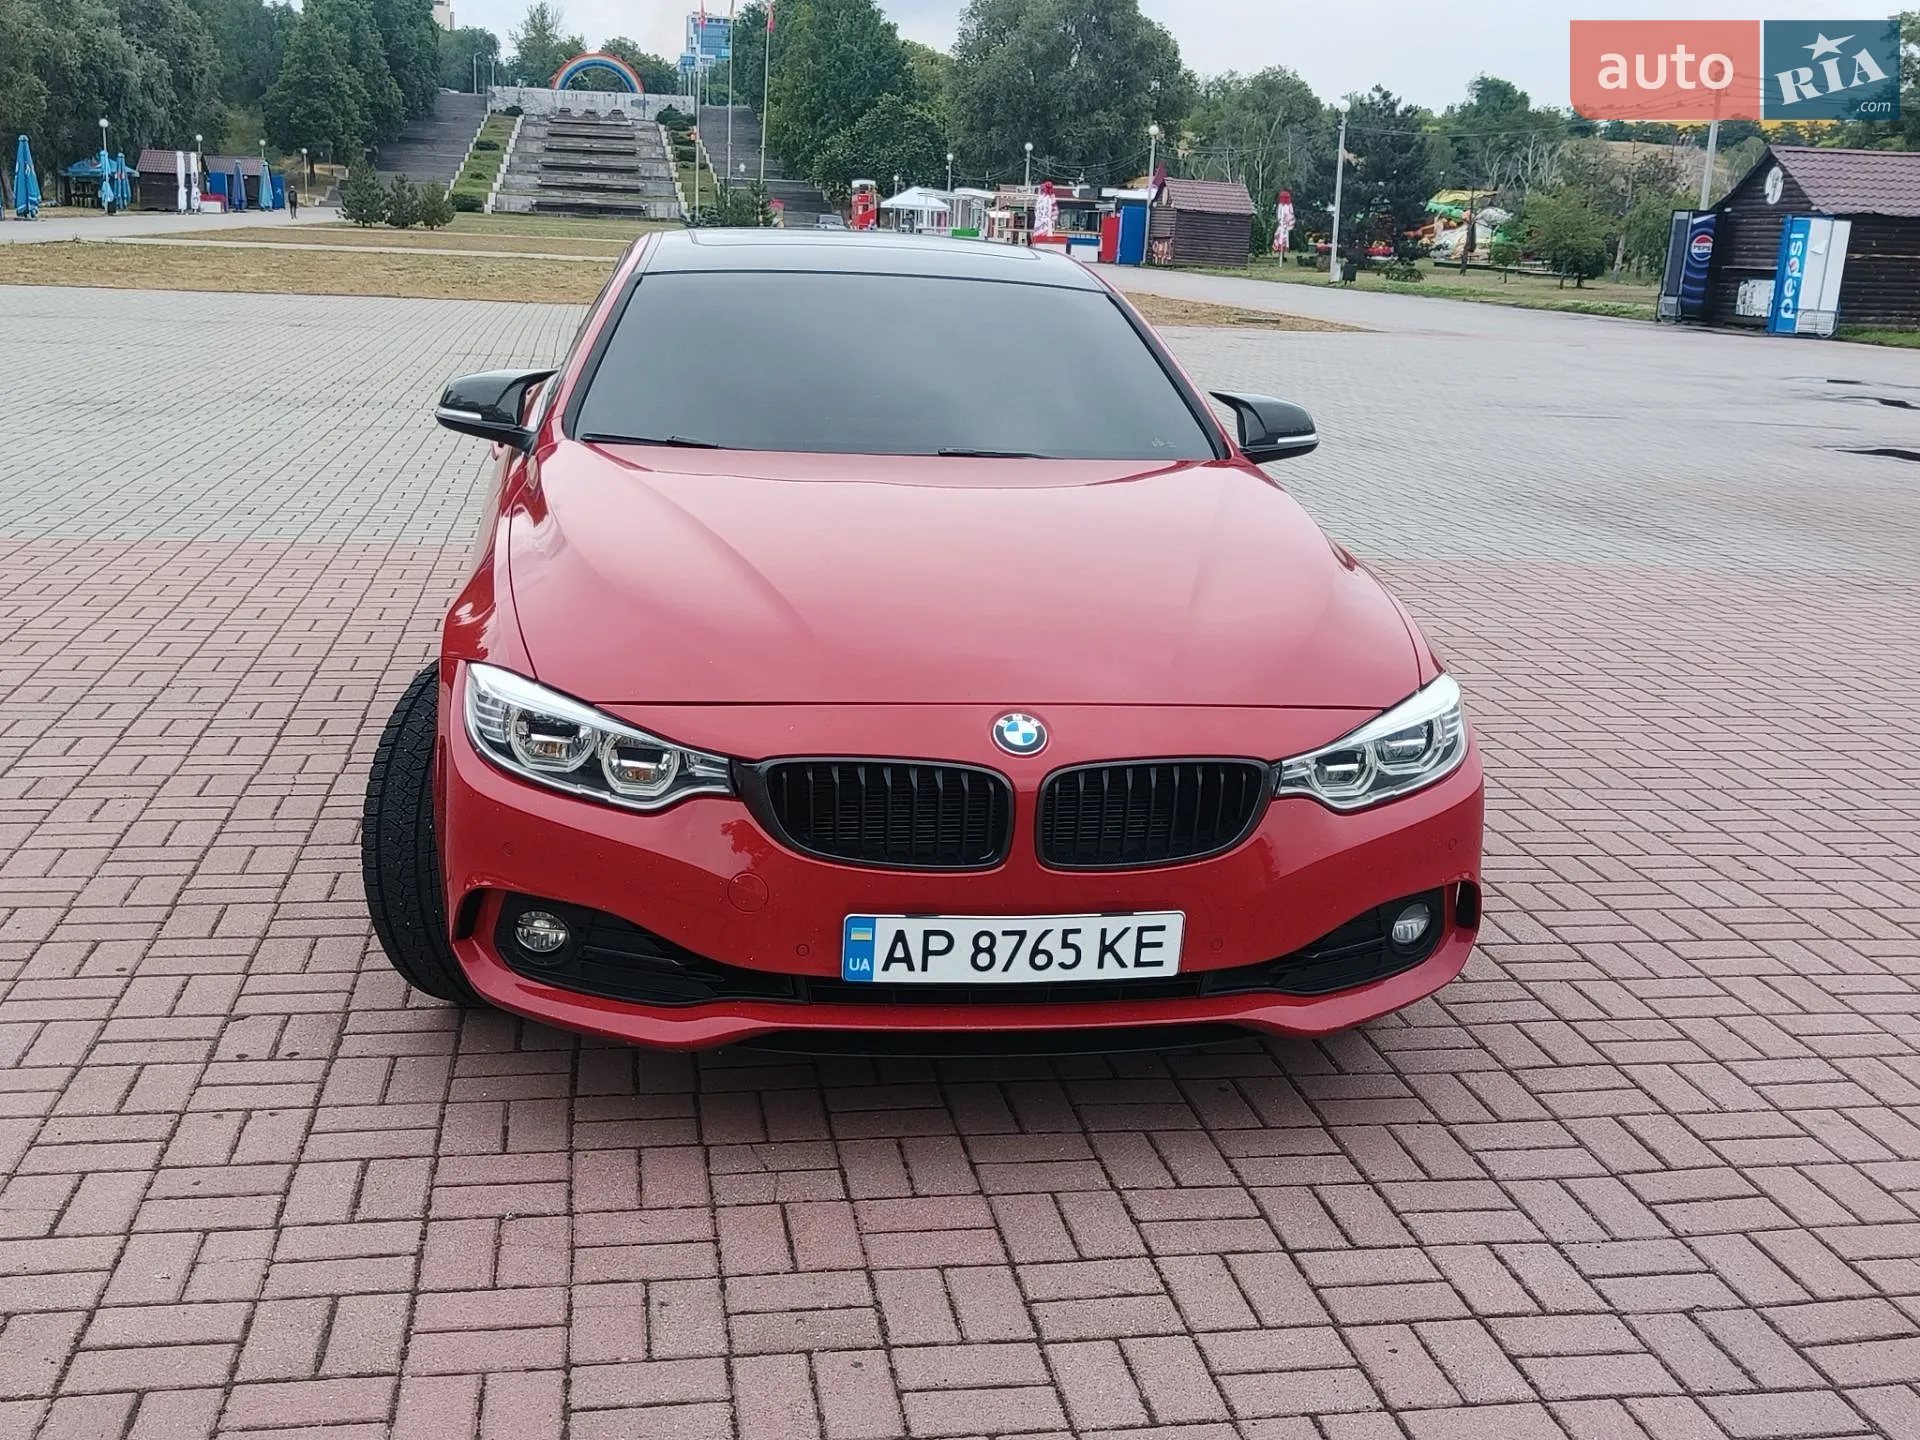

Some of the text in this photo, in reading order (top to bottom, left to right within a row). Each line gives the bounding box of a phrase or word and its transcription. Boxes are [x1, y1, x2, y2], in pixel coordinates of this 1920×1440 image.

[1780, 233, 1805, 319] pepsi
[849, 957, 871, 972] UA
[881, 925, 1167, 972] AP 8765 KE
